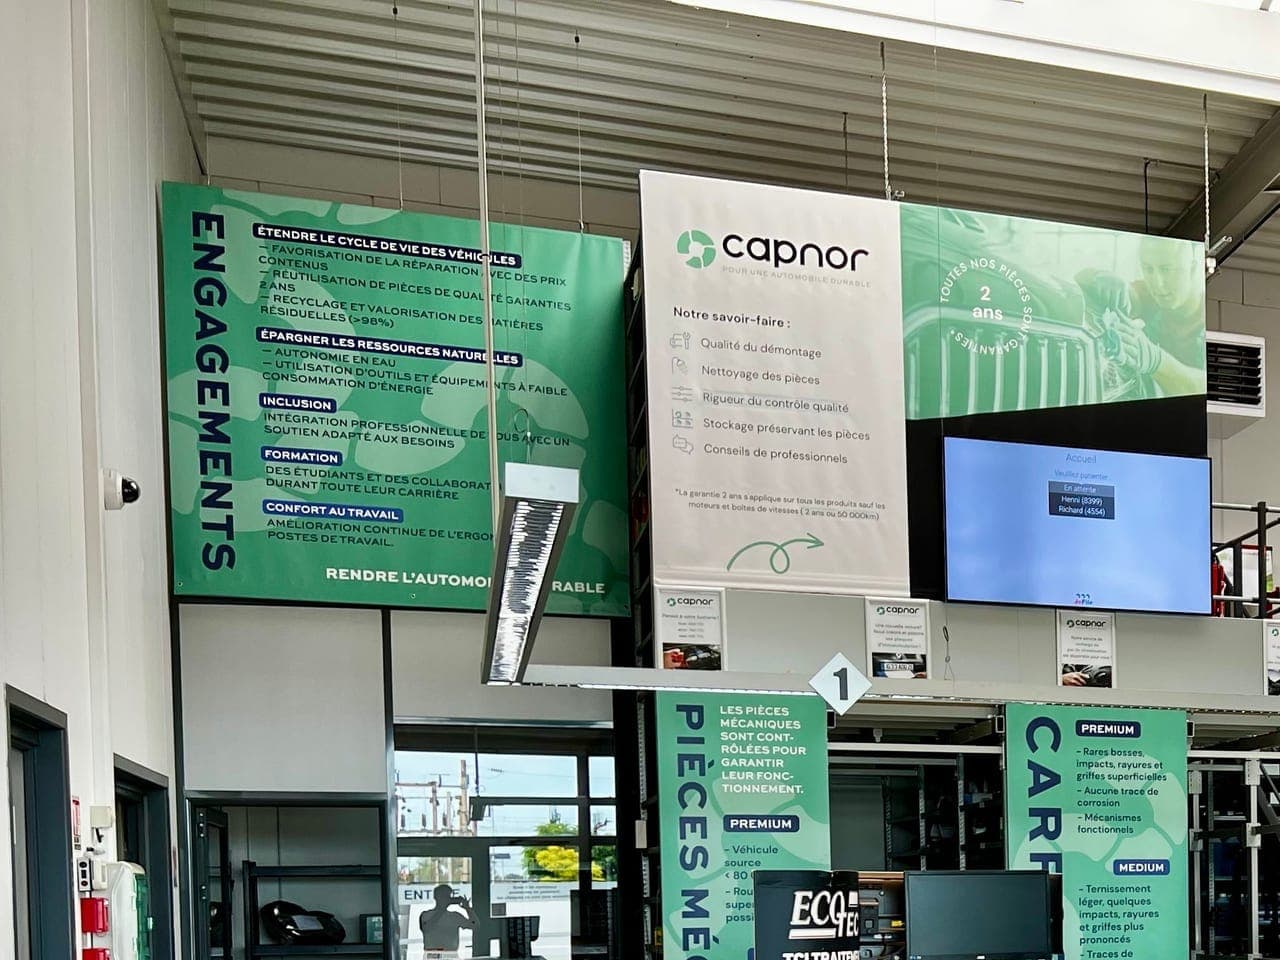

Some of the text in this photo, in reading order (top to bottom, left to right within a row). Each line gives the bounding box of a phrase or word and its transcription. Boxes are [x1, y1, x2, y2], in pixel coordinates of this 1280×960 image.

[258, 225, 446, 257] ÉTENDRE LE CYCLE DE VIE DES
[722, 234, 869, 271] capnor
[258, 255, 328, 270] CONTENUS
[260, 281, 295, 292] 2 ANS
[940, 258, 1032, 340] TOUTES NOS PIÈCES SONT
[980, 286, 991, 301] 2
[261, 305, 346, 322] RÉSIDUELLES
[673, 306, 784, 327] Notre savoir-faire
[972, 306, 1003, 320] ans
[261, 330, 440, 357] ÉPARGNER LES RESSOURCES
[700, 338, 822, 359] Qualité du démontage
[275, 348, 396, 367] AUTONOMIE EN EAU
[701, 365, 820, 385] Nettoyage des pièces
[192, 211, 235, 570] ENGAGEMENTS
[263, 396, 331, 410] INCLUSION
[703, 392, 849, 414] Rigueur du contrôle qualité
[703, 419, 870, 441] Stockage préservant les pièces
[264, 425, 455, 448] SOUTIEN ADAPTÉ AUX BESOINS
[264, 450, 338, 463] FORMATION
[704, 443, 848, 464] Conseils de professionnels
[266, 479, 459, 500] DURANT TOUTE LEUR CARRIÈRE
[266, 503, 399, 520] CONFORT AU TRAVAIL
[268, 531, 338, 543] POSTES DE
[326, 568, 398, 582] RENDRE
[886, 606, 919, 614] capnor
[1075, 618, 1107, 628] capnor
[833, 667, 848, 700] 1
[720, 705, 789, 716] LES PIÈCES
[720, 717, 801, 729] MÉCANIQUES
[1081, 724, 1134, 735] PREMIUM
[720, 732, 794, 741] SONT CONT-
[721, 743, 806, 755] RÔLÉES POUR
[1083, 748, 1108, 756] Rares
[721, 758, 784, 767] GARANTIR
[1118, 762, 1152, 770] rayures
[722, 771, 794, 781] LEUR FONC-
[1076, 772, 1167, 782] griffes superficielles
[676, 704, 715, 872] PIÈCES
[722, 784, 804, 794] TIONNEMENT.
[1084, 786, 1119, 795] Aucune
[1147, 788, 1159, 796] de
[1077, 799, 1120, 807] corrosion
[1084, 813, 1142, 821] Mécanismes
[730, 818, 792, 830] PREMIUM
[1077, 825, 1134, 833] fonctionnels
[732, 844, 778, 855] Véhicule
[724, 858, 761, 868] source
[1119, 863, 1164, 872] MEDIUM
[1086, 884, 1151, 893] Ternissement
[1107, 897, 1152, 908] quelques
[1123, 911, 1159, 920] rayures
[1092, 922, 1144, 933] griffes plus
[1079, 935, 1131, 946] prononcés
[1086, 949, 1133, 958] Traces de
